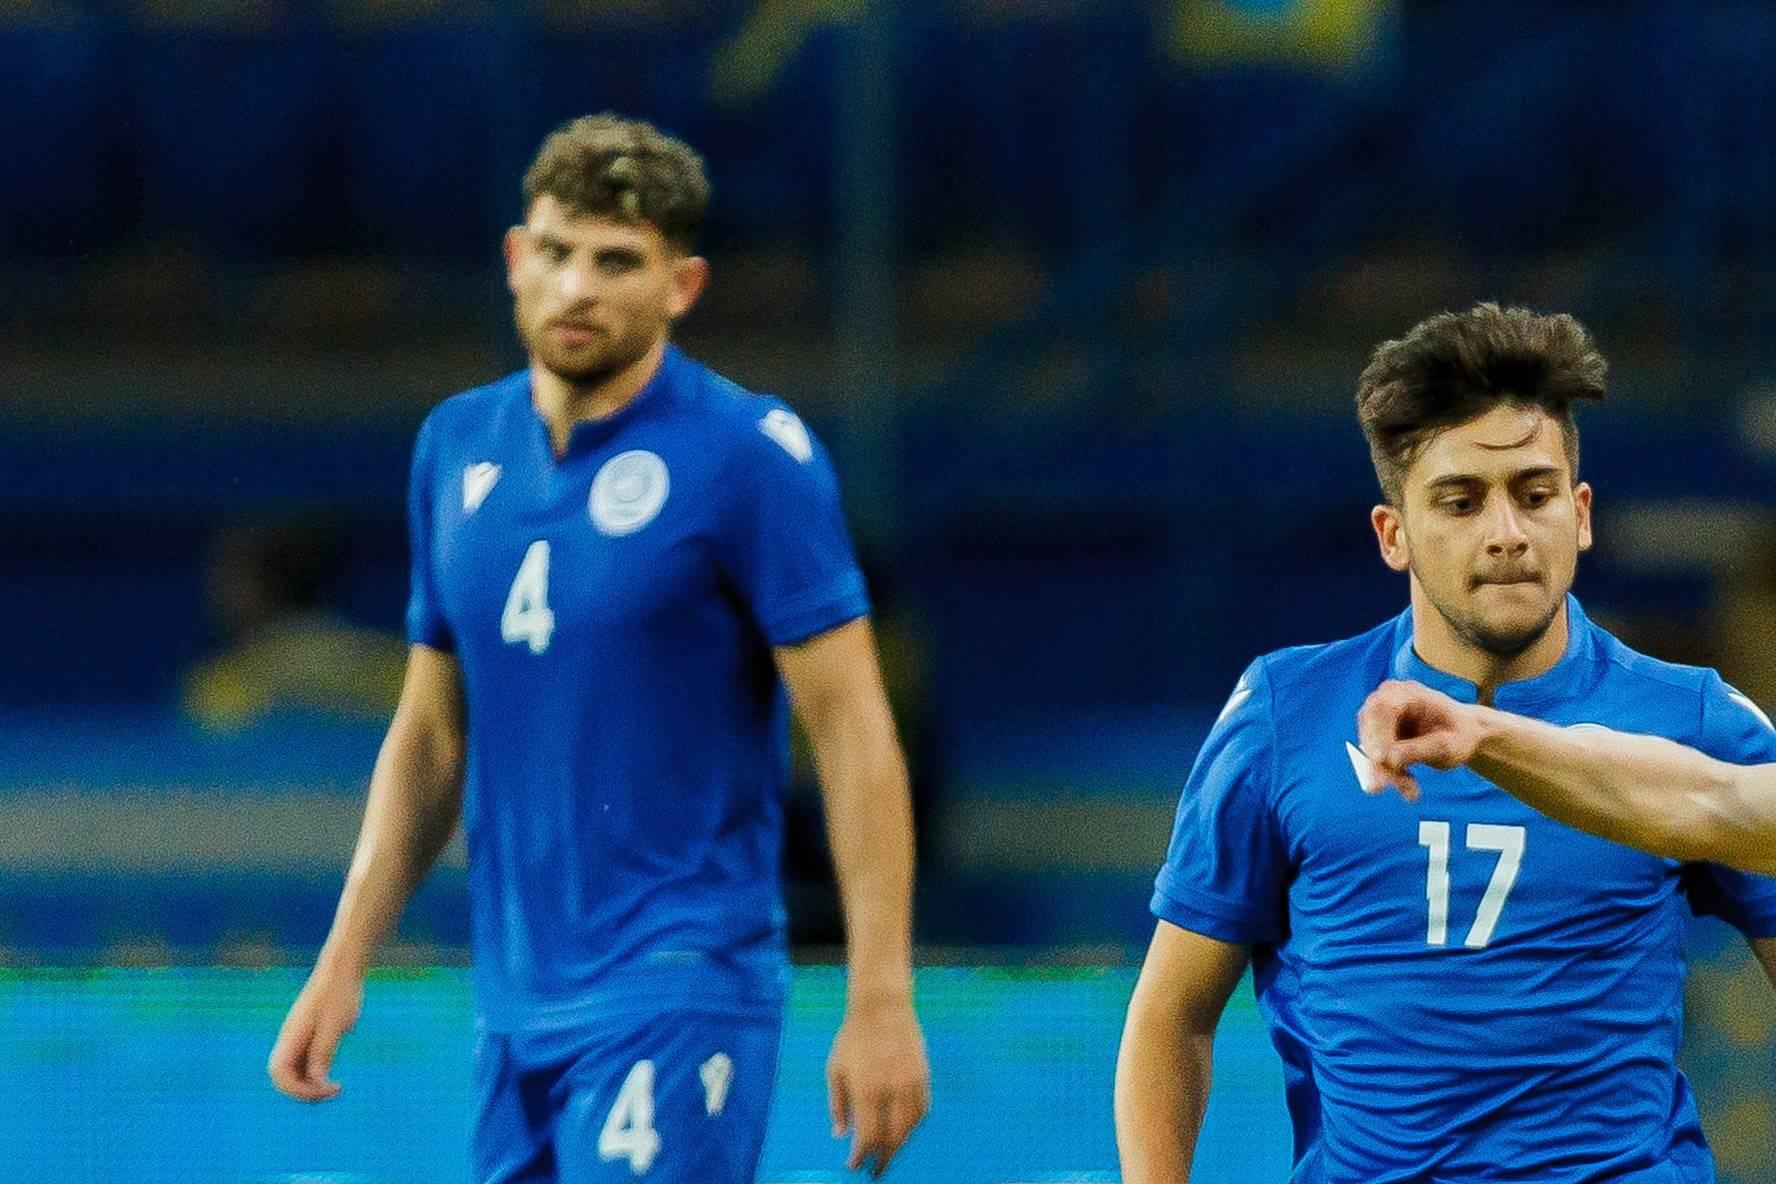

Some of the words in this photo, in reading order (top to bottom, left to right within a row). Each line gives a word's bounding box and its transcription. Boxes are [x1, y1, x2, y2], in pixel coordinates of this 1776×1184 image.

[502, 539, 555, 655] 4
[1419, 821, 1525, 947] 17
[599, 1059, 661, 1175] 4
